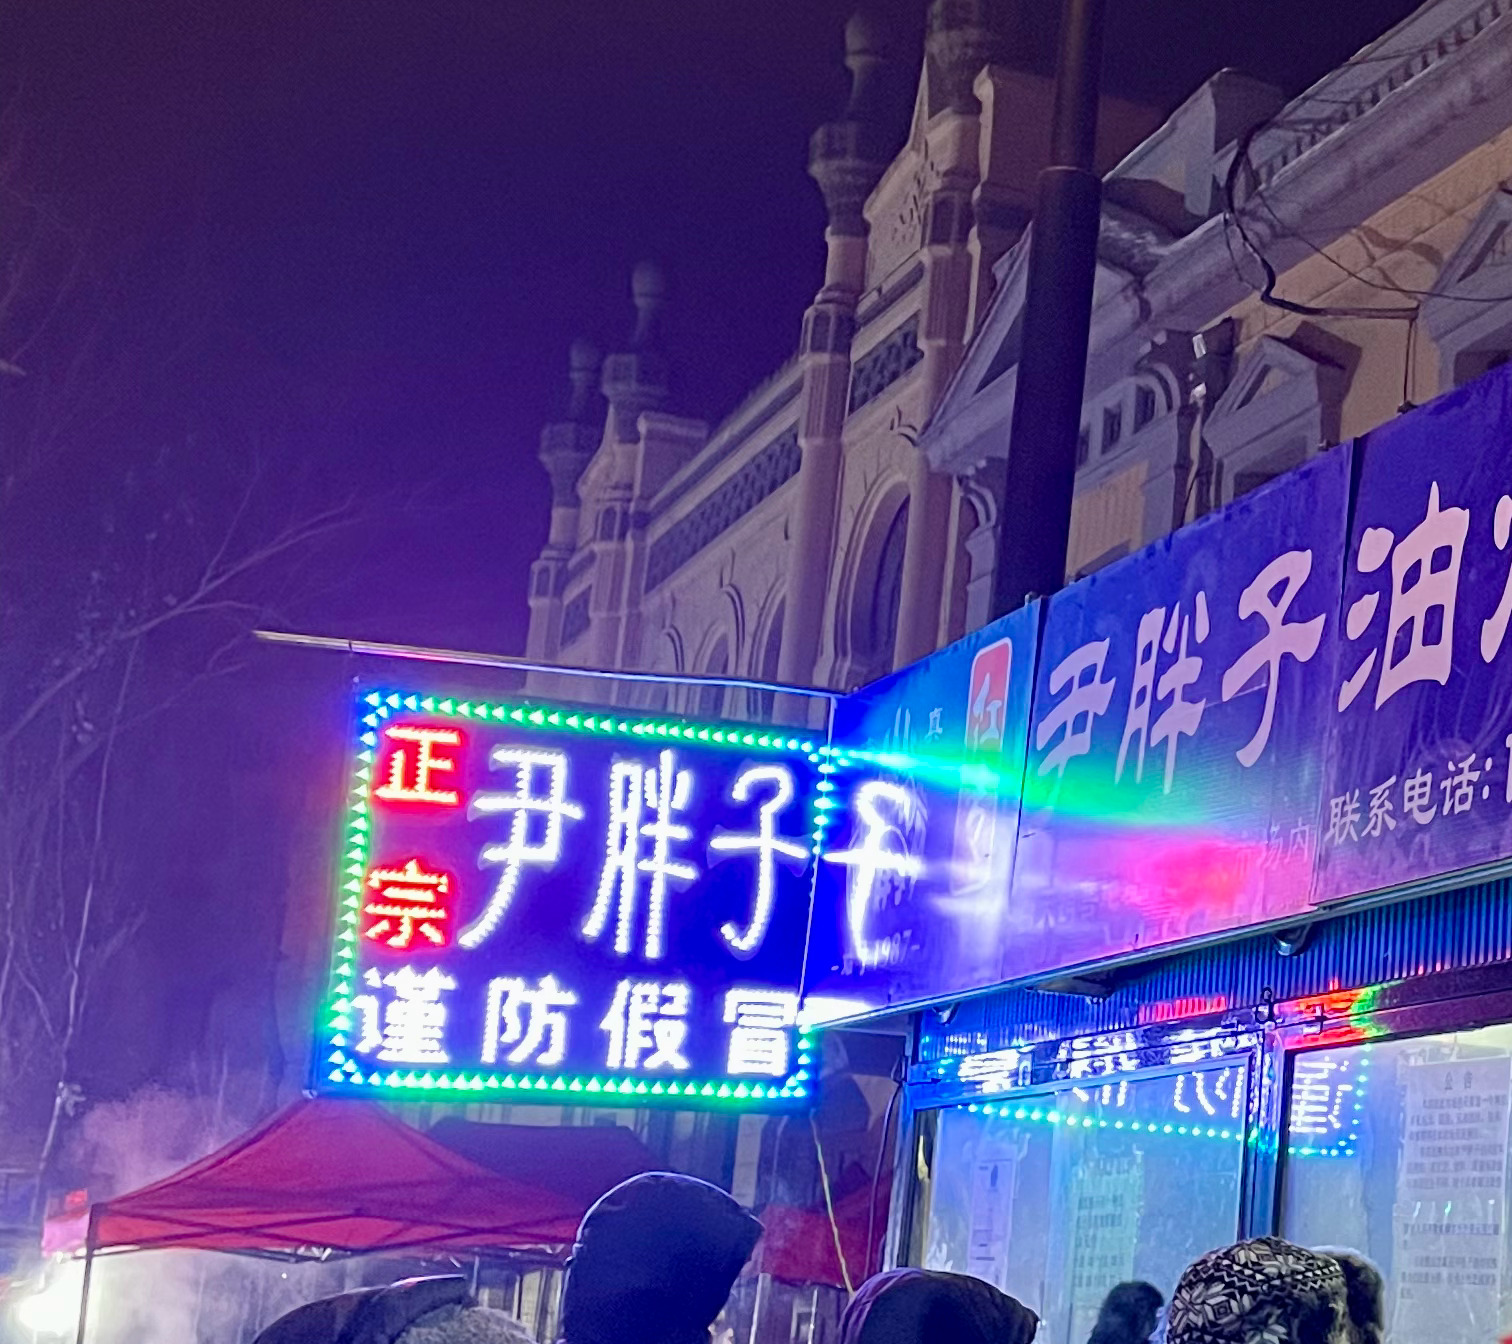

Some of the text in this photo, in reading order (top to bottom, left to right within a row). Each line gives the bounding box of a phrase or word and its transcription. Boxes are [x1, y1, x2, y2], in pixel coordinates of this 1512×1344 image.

[364, 725, 462, 949] 正宗
[458, 745, 809, 959] 尹胖子
[352, 965, 804, 1076] 谨防假冒
